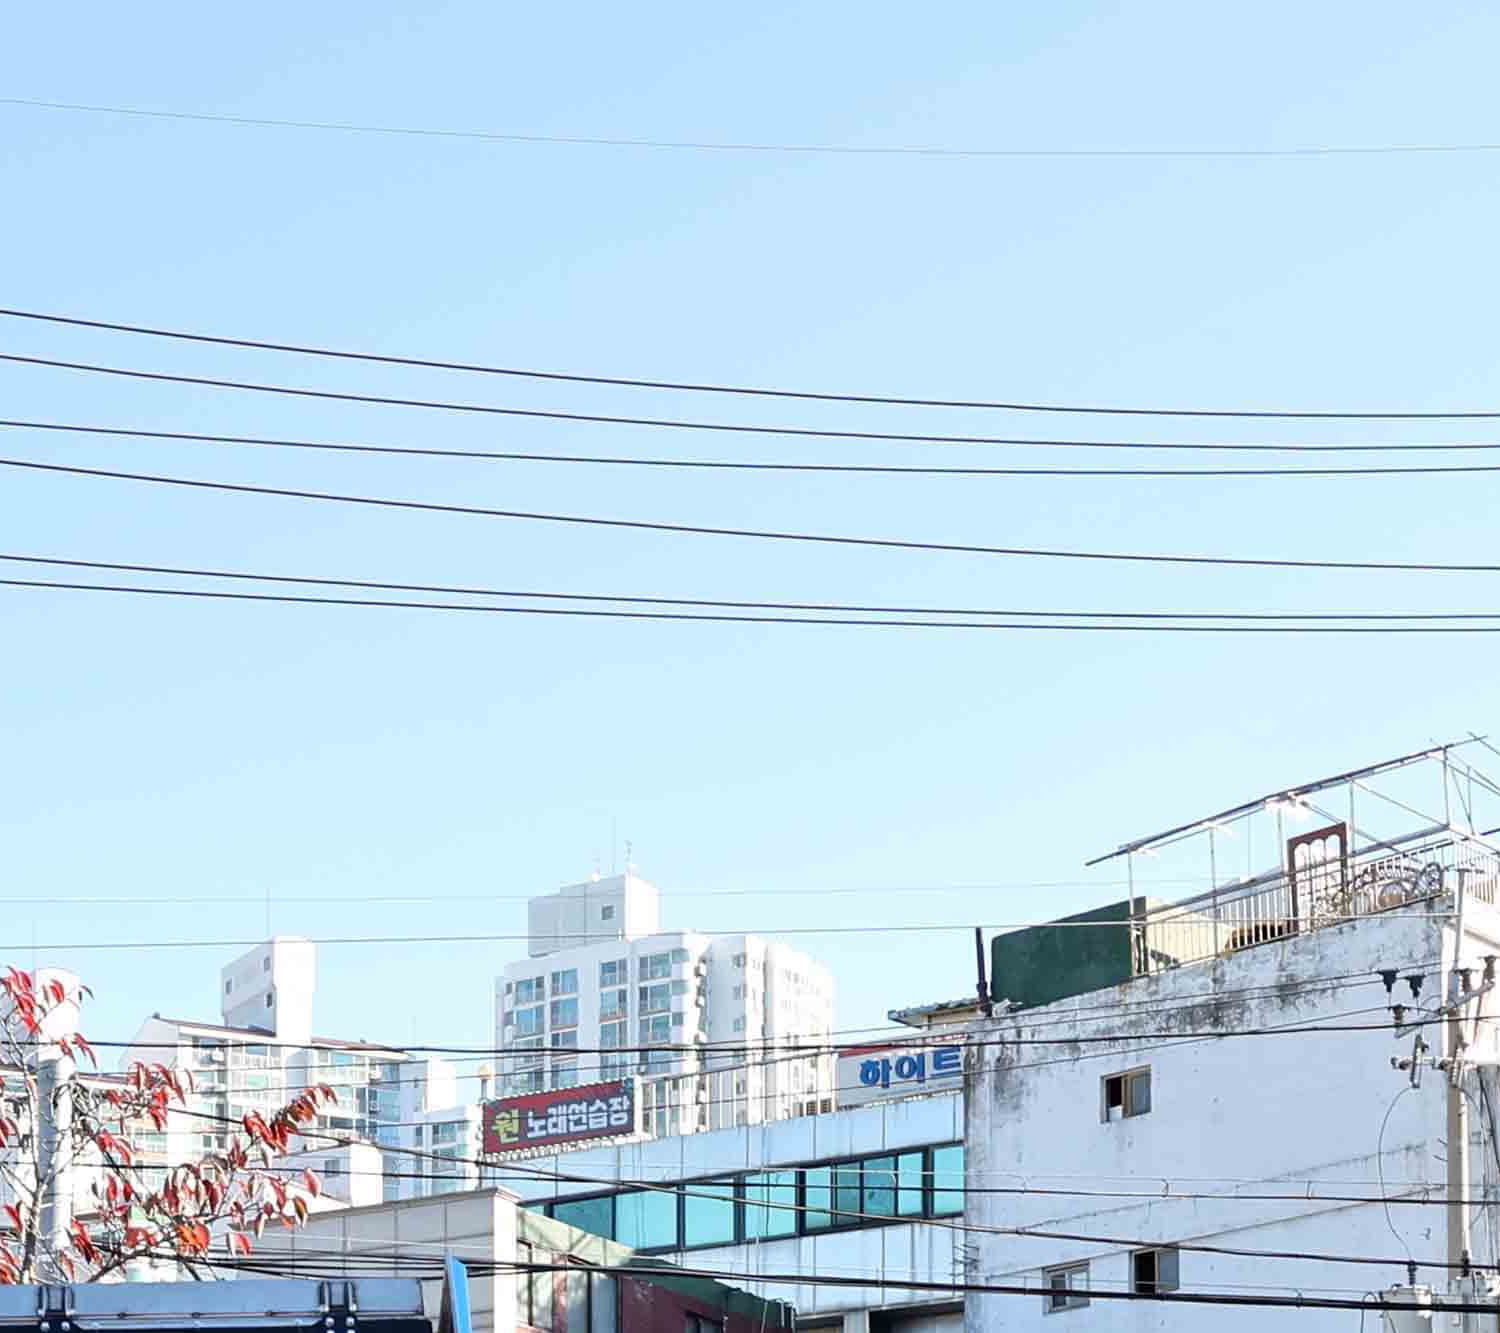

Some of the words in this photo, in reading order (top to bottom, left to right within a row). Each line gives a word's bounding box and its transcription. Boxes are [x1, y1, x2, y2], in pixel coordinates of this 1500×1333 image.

[860, 1046, 961, 1088] 하이트
[491, 1110, 520, 1144] 원
[527, 1096, 633, 1138] 노래연습장
